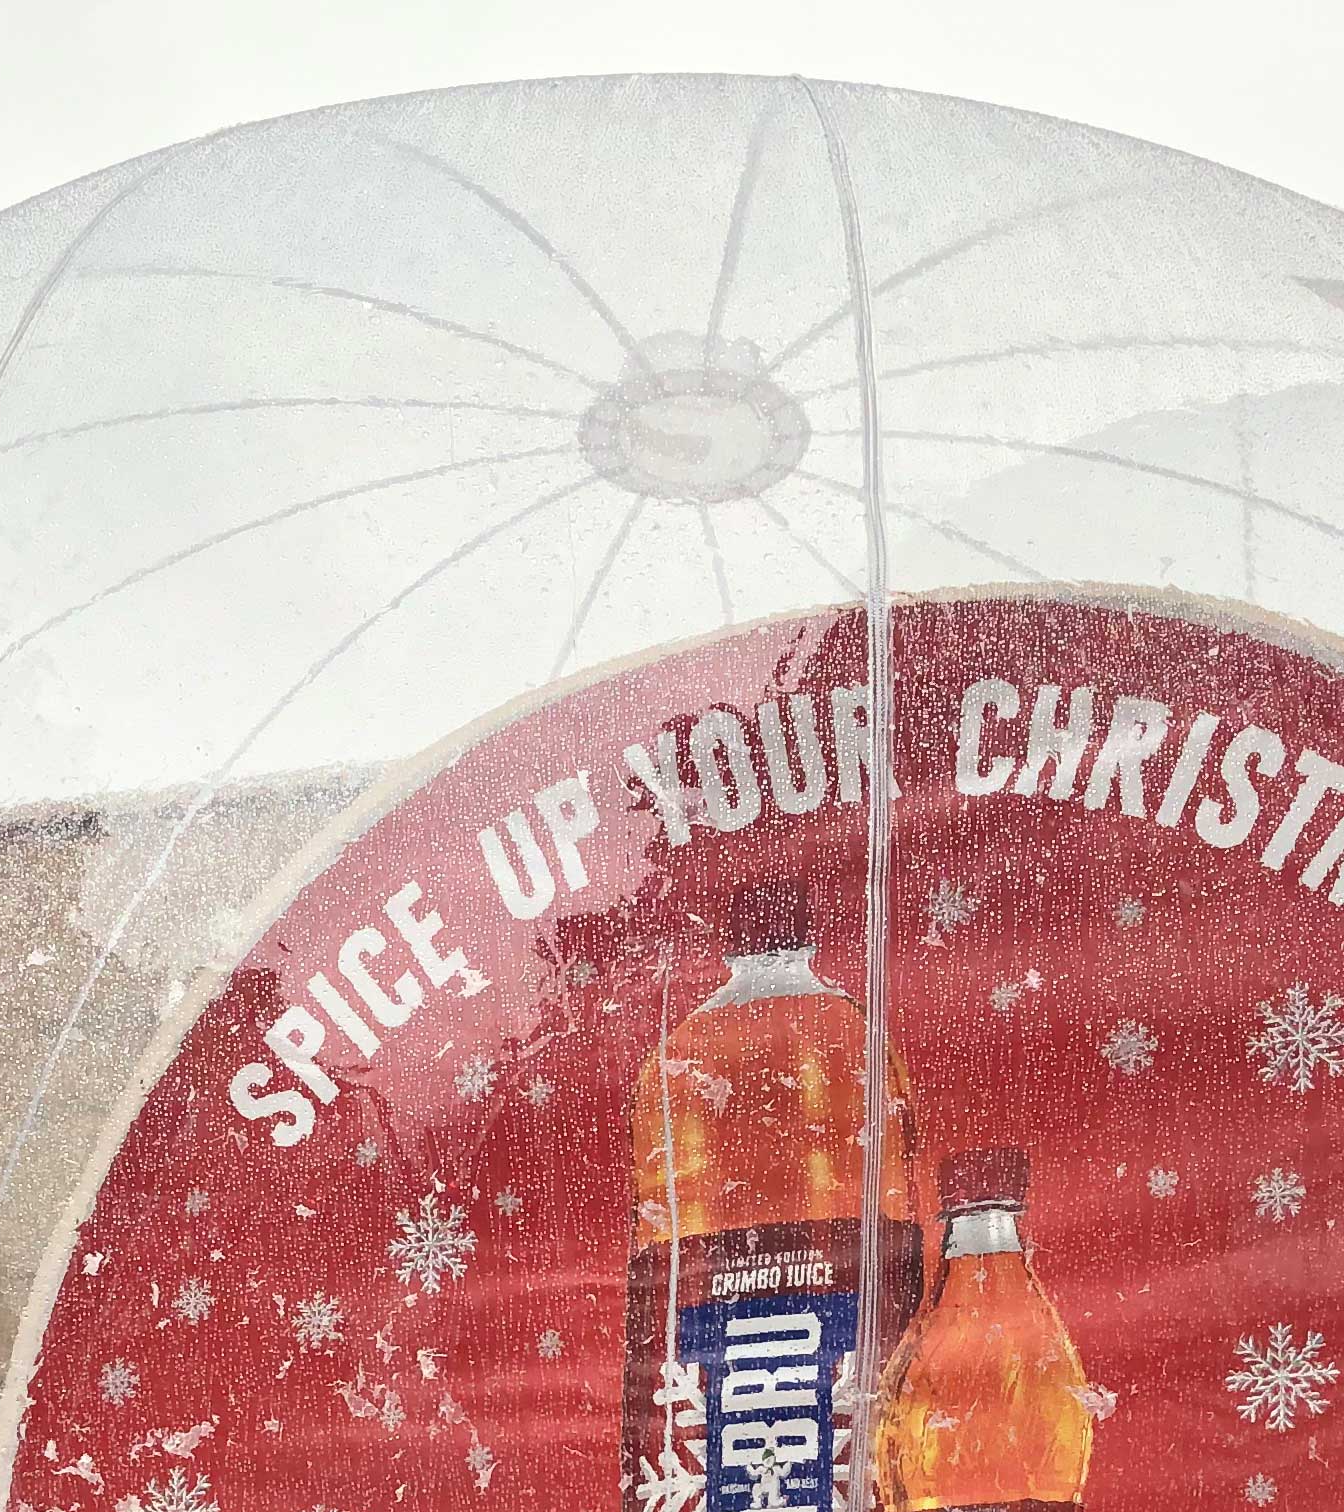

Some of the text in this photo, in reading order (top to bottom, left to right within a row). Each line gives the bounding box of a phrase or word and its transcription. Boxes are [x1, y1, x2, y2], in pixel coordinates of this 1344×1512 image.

[231, 880, 471, 1147] SPICE
[477, 770, 602, 919] UP
[623, 683, 902, 848] YOUR
[711, 1262, 834, 1296] CRIMBO JUICE
